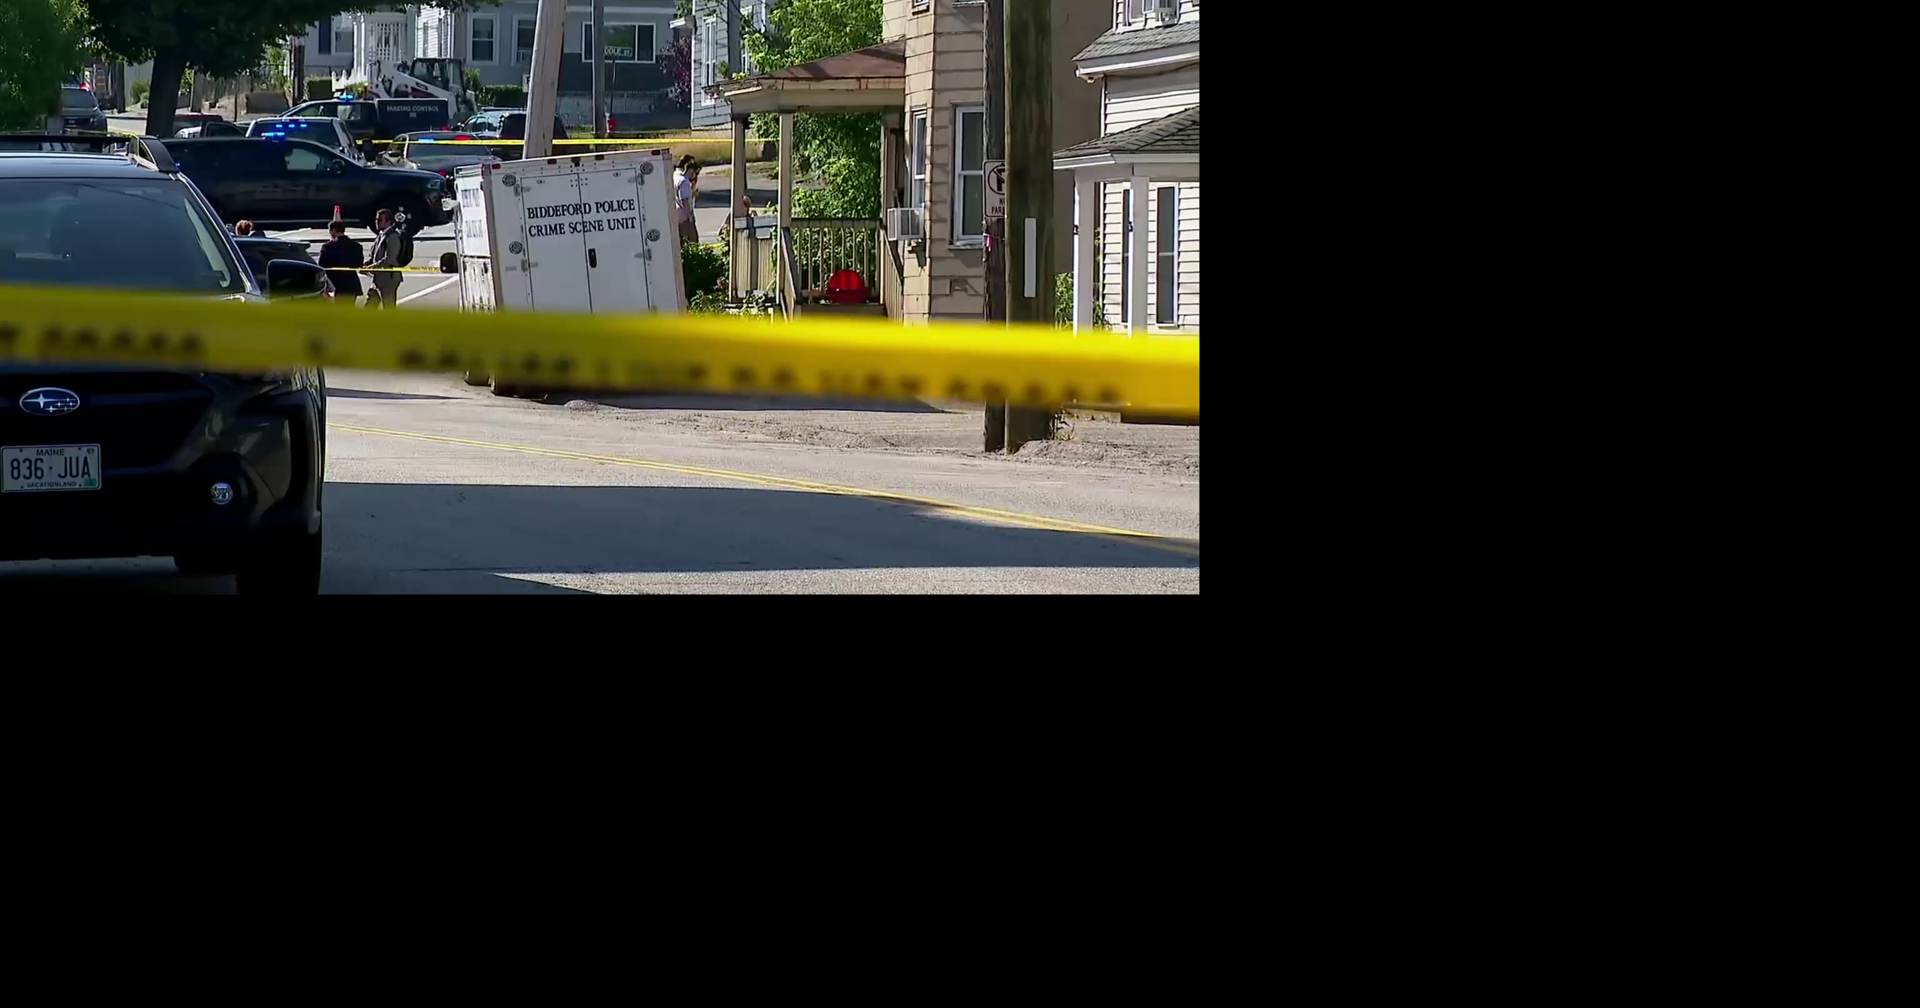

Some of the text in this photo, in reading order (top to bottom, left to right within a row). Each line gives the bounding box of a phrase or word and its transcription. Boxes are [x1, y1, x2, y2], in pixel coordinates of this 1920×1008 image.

[527, 199, 636, 219] BIDDEFORD POLICE
[528, 216, 637, 237] CRIME SCENE UNIT
[36, 448, 66, 456] MAINE
[10, 456, 92, 480] 836 JUA
